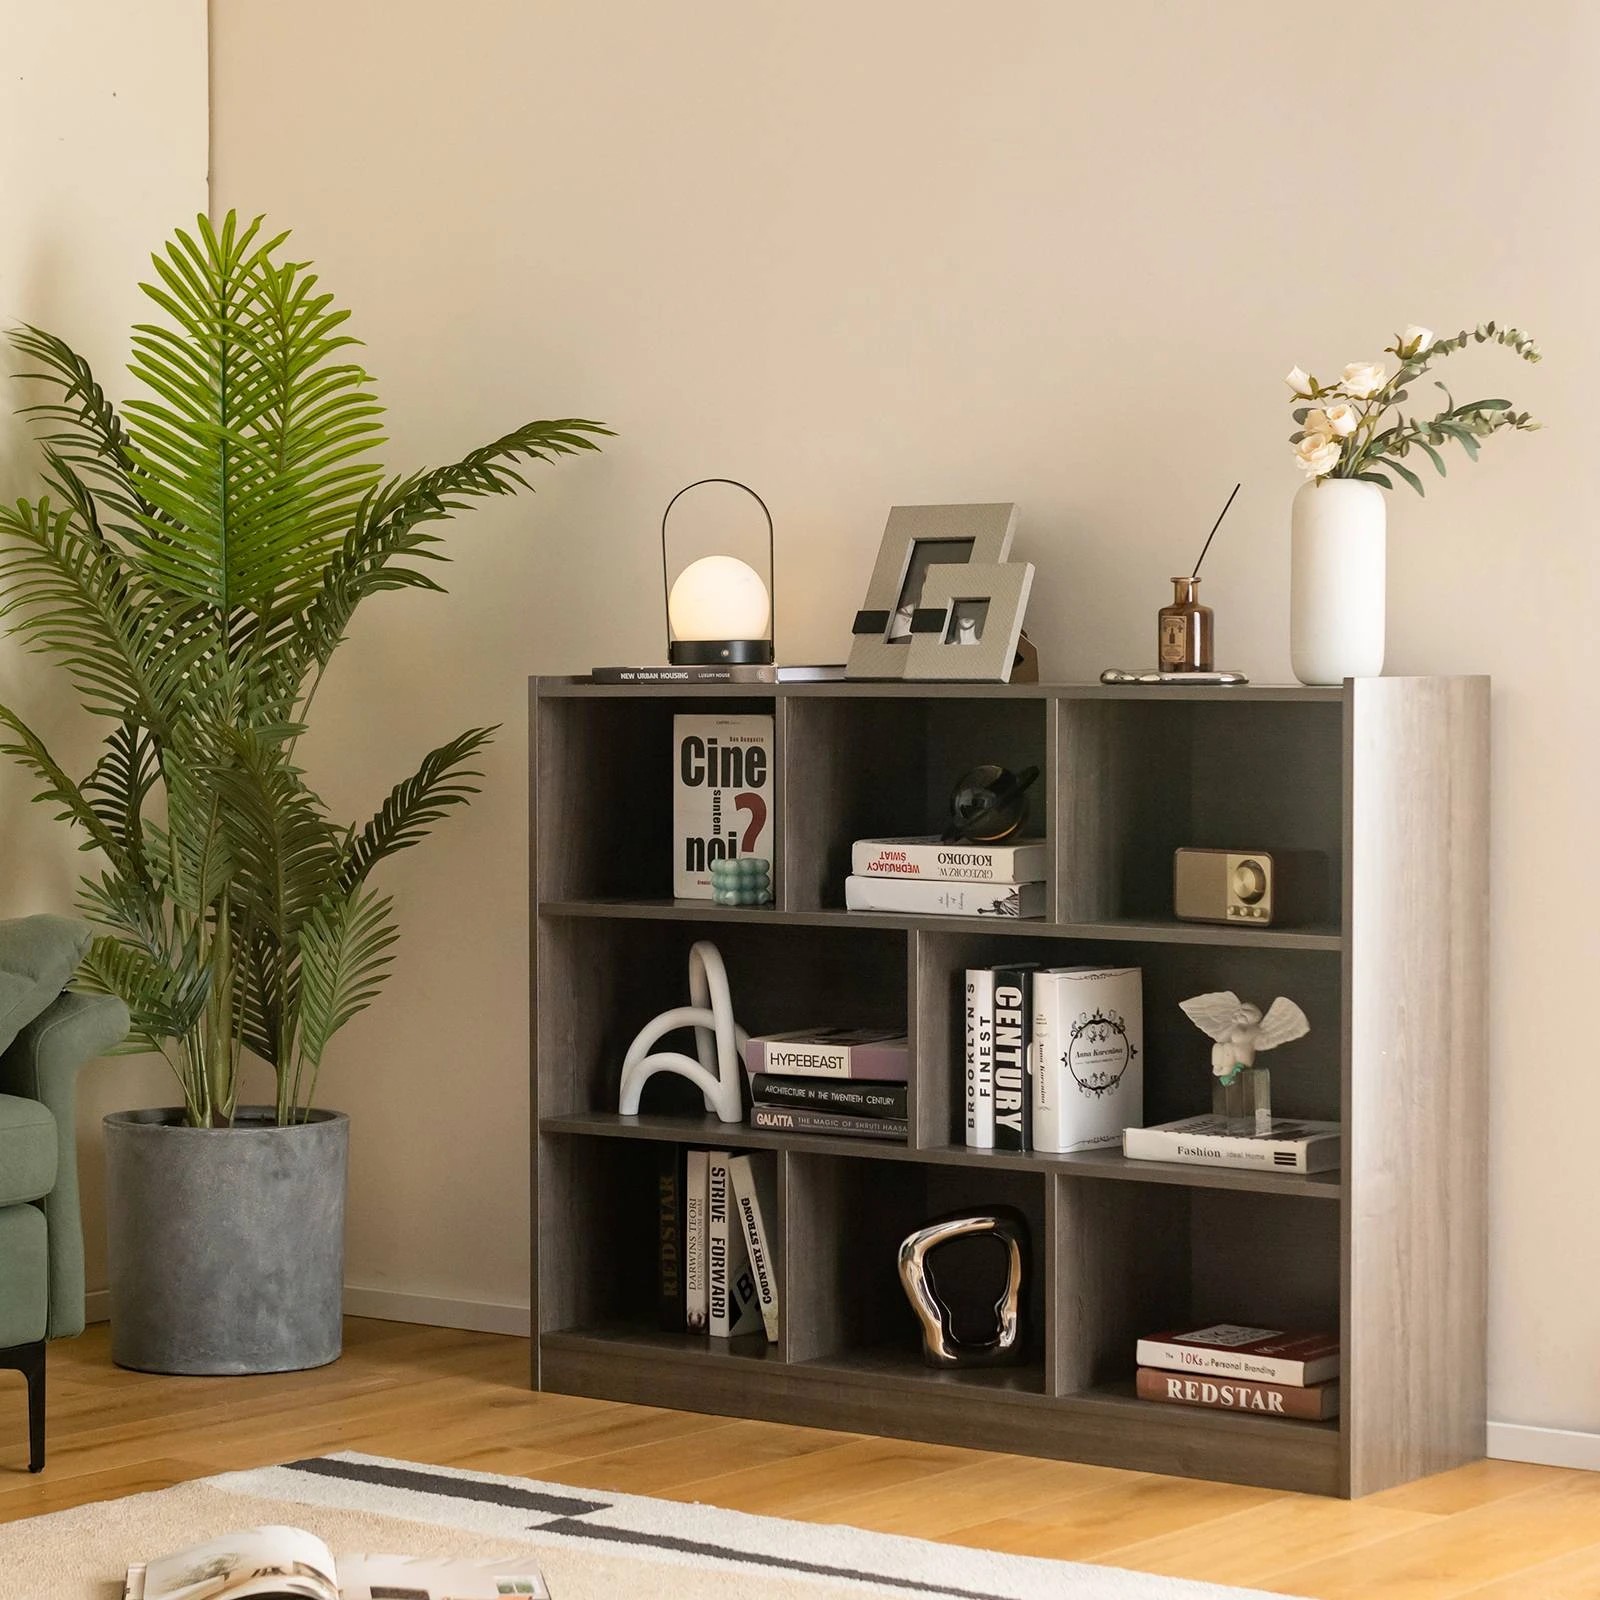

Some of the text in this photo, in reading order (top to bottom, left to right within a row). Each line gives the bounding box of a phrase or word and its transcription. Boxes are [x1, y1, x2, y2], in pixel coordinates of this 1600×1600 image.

[620, 672, 689, 680] NEW URBAN HOUSING
[681, 735, 767, 789] Cine
[713, 789, 721, 835] suntem
[937, 852, 992, 867] KOŁODKO
[948, 868, 993, 879] GRZEGORZ
[770, 1052, 845, 1070] HYPEBEAST
[967, 983, 975, 1129] BROOKLYN'S
[980, 1016, 991, 1098] FINEST
[994, 986, 1023, 1132] CENTURY
[1075, 1048, 1123, 1058] Anna Karenina
[765, 1085, 895, 1106] ARCHITECTURE IN THE TWENTIETH CENTURY
[756, 1113, 794, 1128] GALATTA
[798, 1117, 810, 1125] THE
[813, 1118, 839, 1127] MAGIC
[841, 1120, 852, 1128] OF
[1177, 1145, 1221, 1158] Fashion
[659, 1175, 677, 1296] REDSTAR
[688, 1198, 697, 1291] DARWINS TEORI
[711, 1167, 726, 1319] STRIVE FORWARD
[741, 1197, 772, 1305] COUNTRY STRONG
[1179, 1352, 1203, 1366] 10Ks
[1210, 1358, 1242, 1371] Personal
[1244, 1362, 1276, 1377] Branding
[1166, 1377, 1286, 1413] REDSTAR
